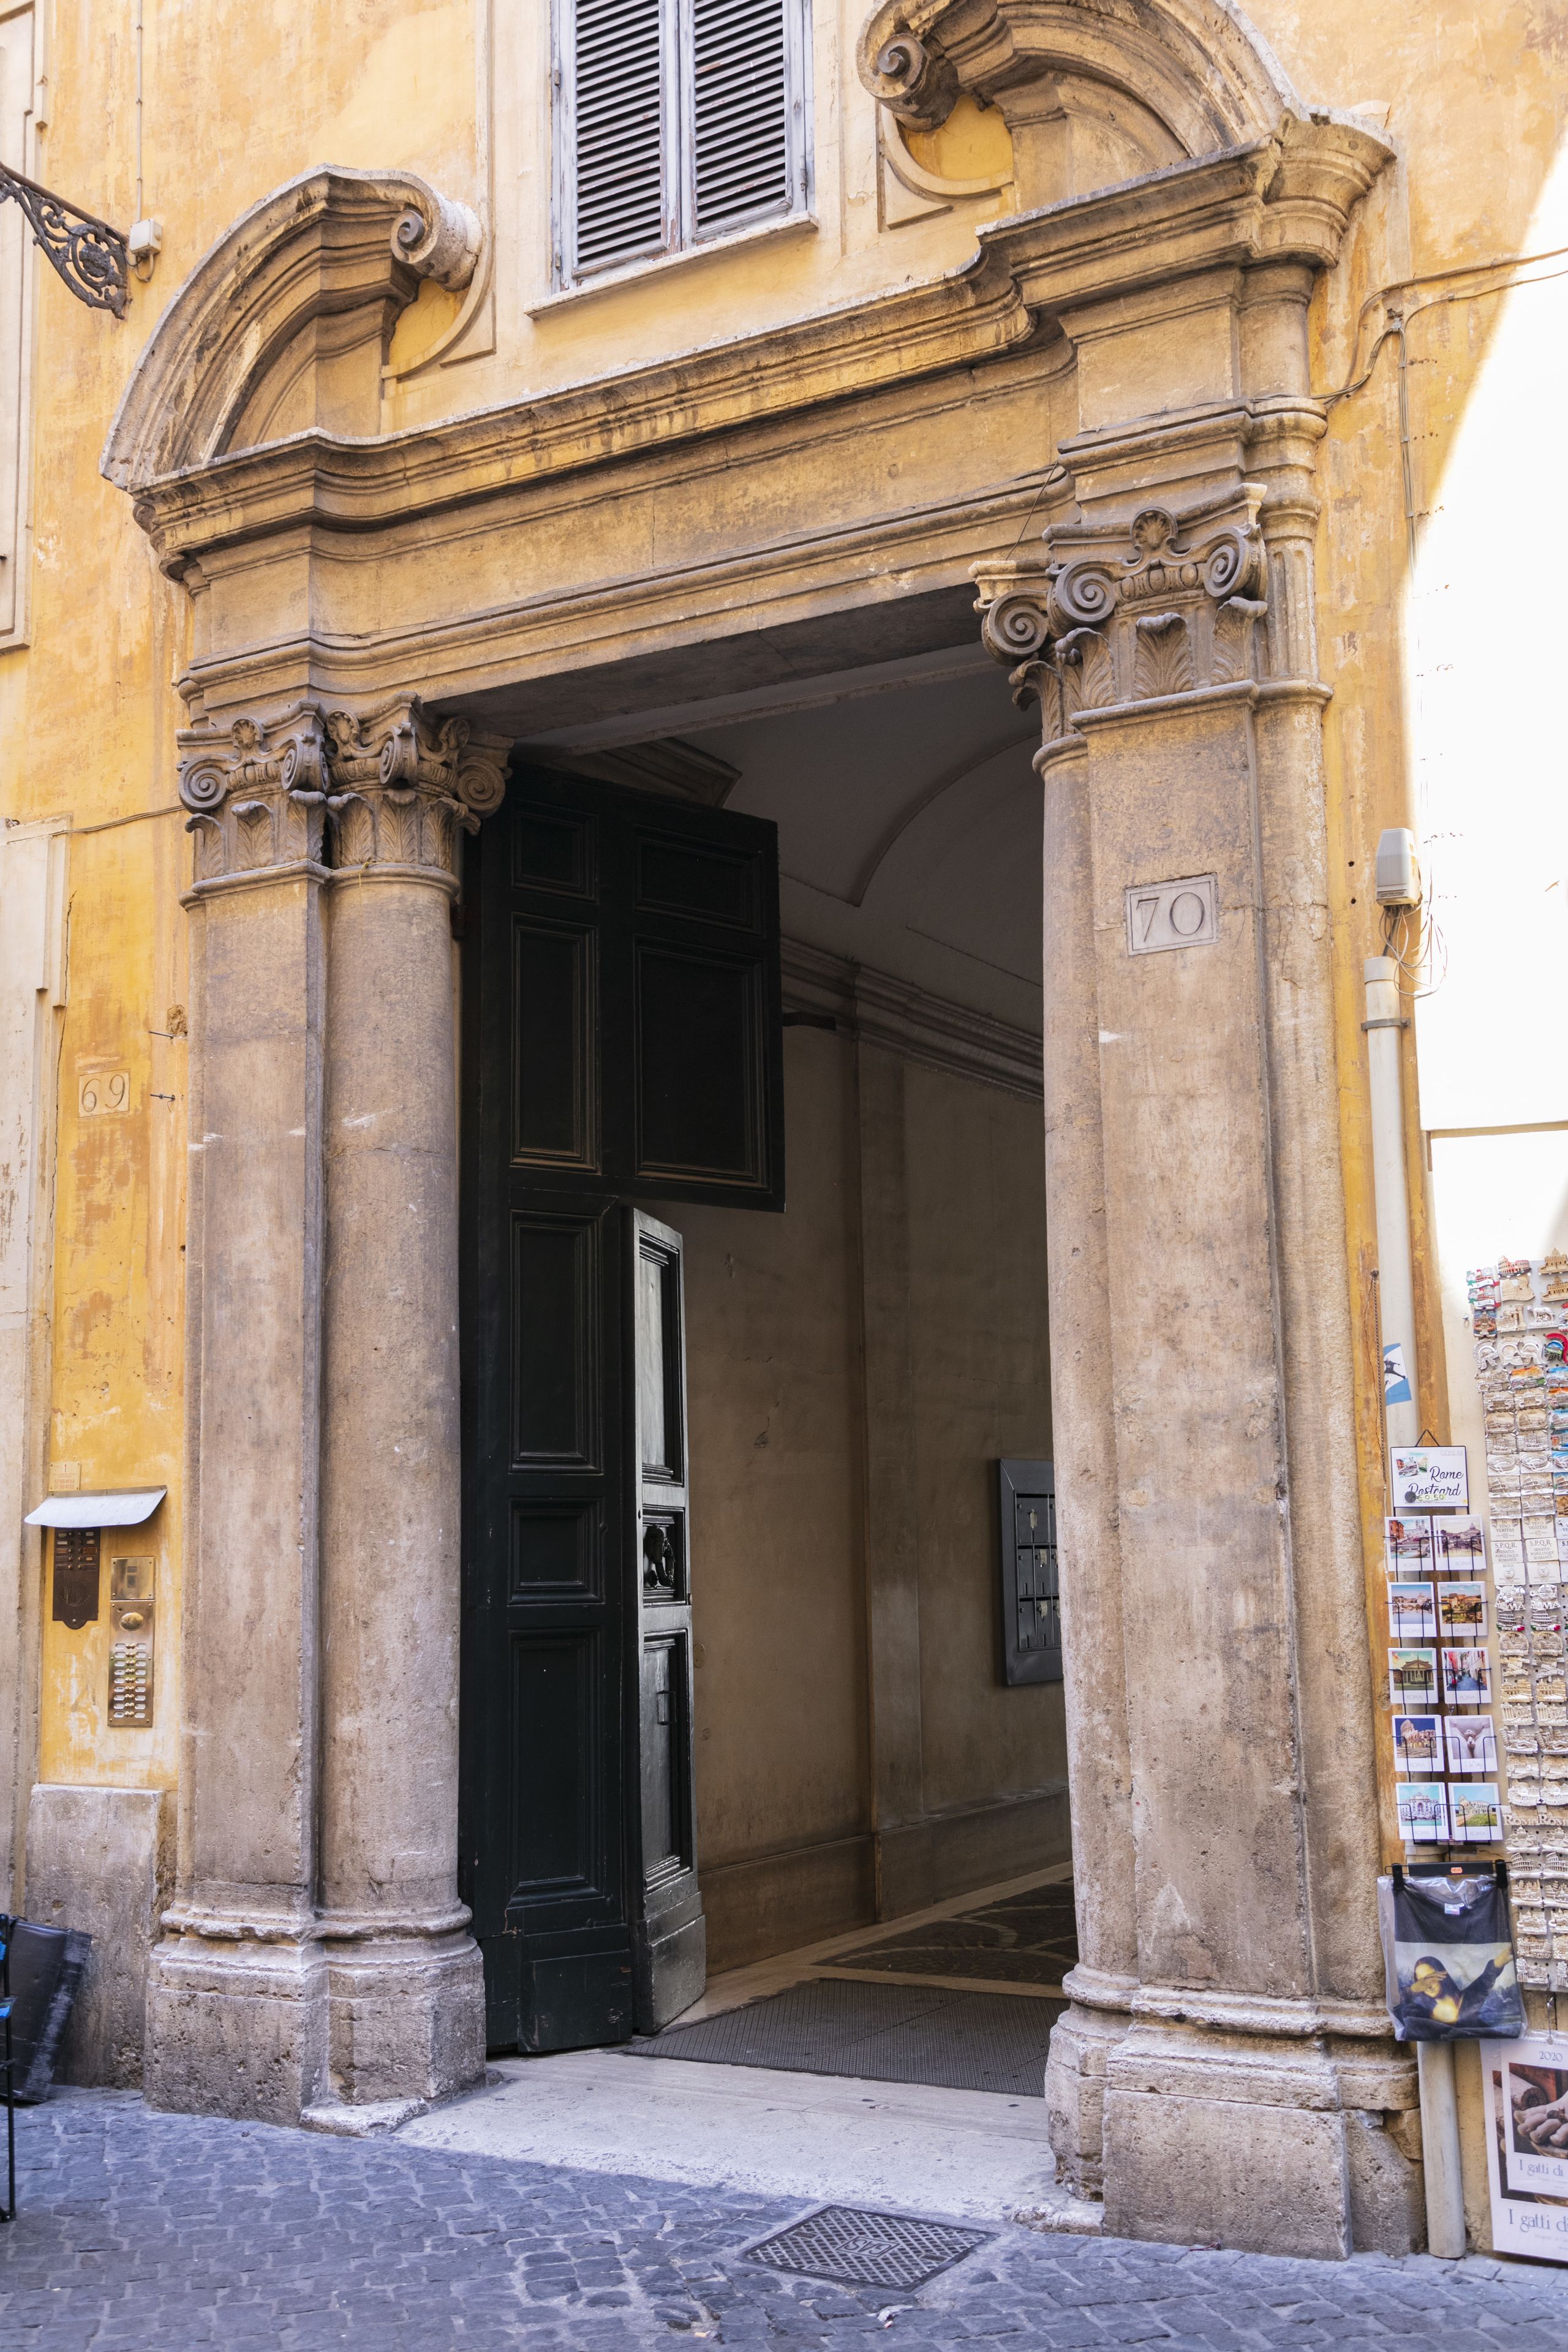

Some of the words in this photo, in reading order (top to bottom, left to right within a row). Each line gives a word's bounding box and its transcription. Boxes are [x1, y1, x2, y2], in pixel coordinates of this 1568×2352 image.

[1136, 892, 1205, 943] 70
[81, 1074, 126, 1112] 69
[1430, 1466, 1464, 1482] Rome
[1408, 1483, 1461, 1496] Postcard
[1504, 1814, 1539, 1825] ROMA
[1539, 1814, 1568, 1825] ROM
[1539, 2051, 1563, 2062] 2020
[1519, 2159, 1524, 2170] I
[1527, 2163, 1549, 2176] gatti
[1553, 2164, 1564, 2177] di
[1508, 2208, 1514, 2225] I
[1520, 2214, 1551, 2233] gatti
[844, 2239, 892, 2255] GAS
